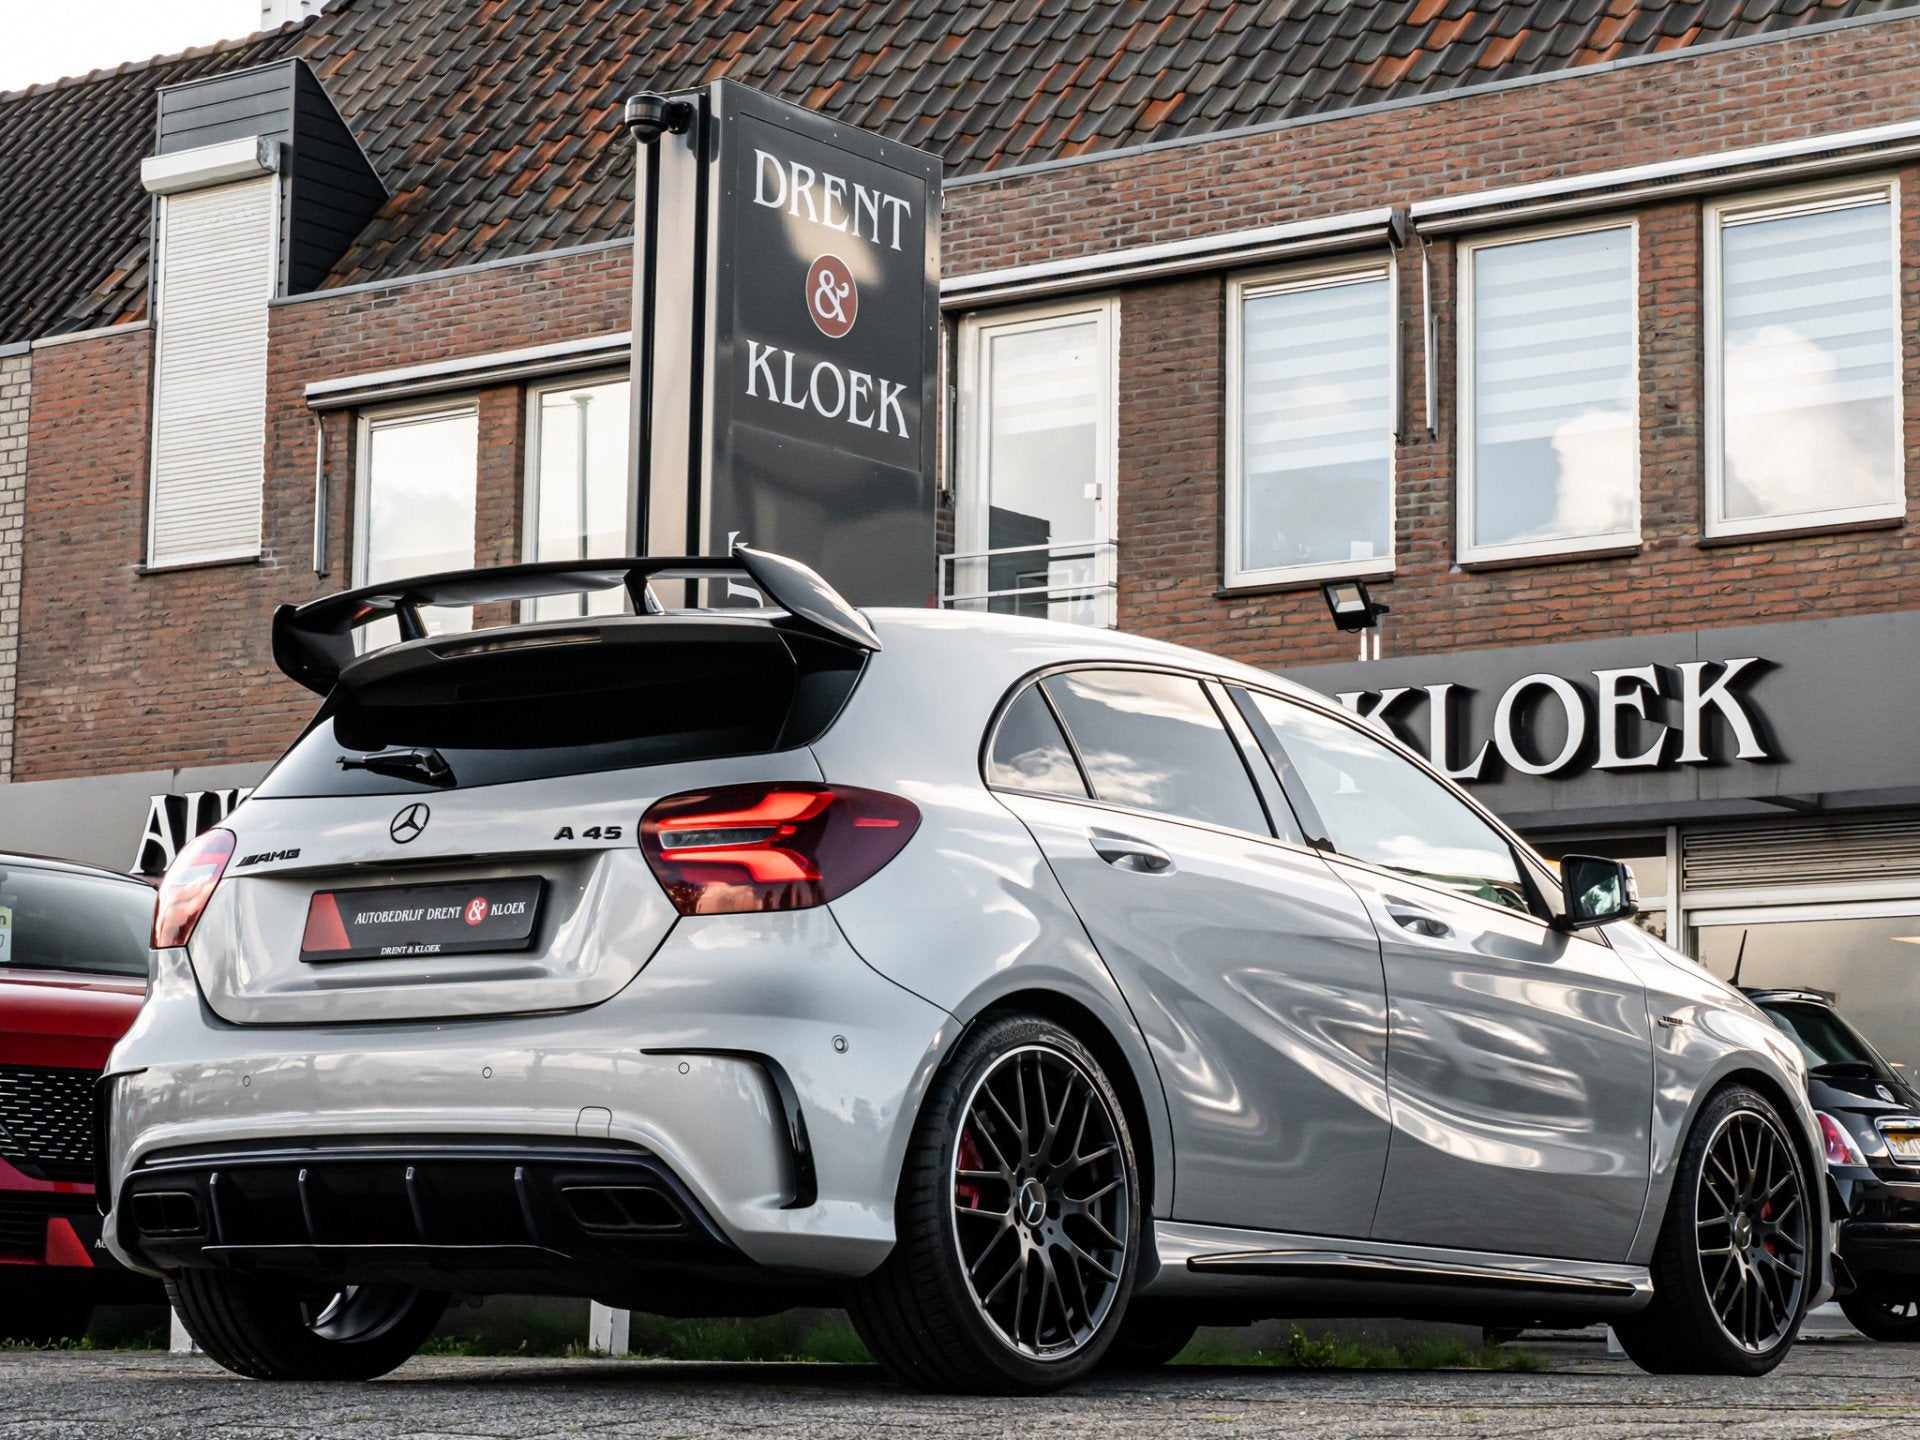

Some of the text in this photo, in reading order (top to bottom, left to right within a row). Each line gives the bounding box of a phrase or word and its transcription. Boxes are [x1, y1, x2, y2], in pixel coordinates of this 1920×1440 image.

[753, 148, 911, 251] DRENT
[814, 268, 850, 324] &
[745, 339, 910, 439] KLOEK
[553, 826, 623, 841] A 45
[354, 899, 527, 925] AUTOBEDRIJF DRENT & KLOEK
[380, 944, 441, 955] DRENT & KLOEK
